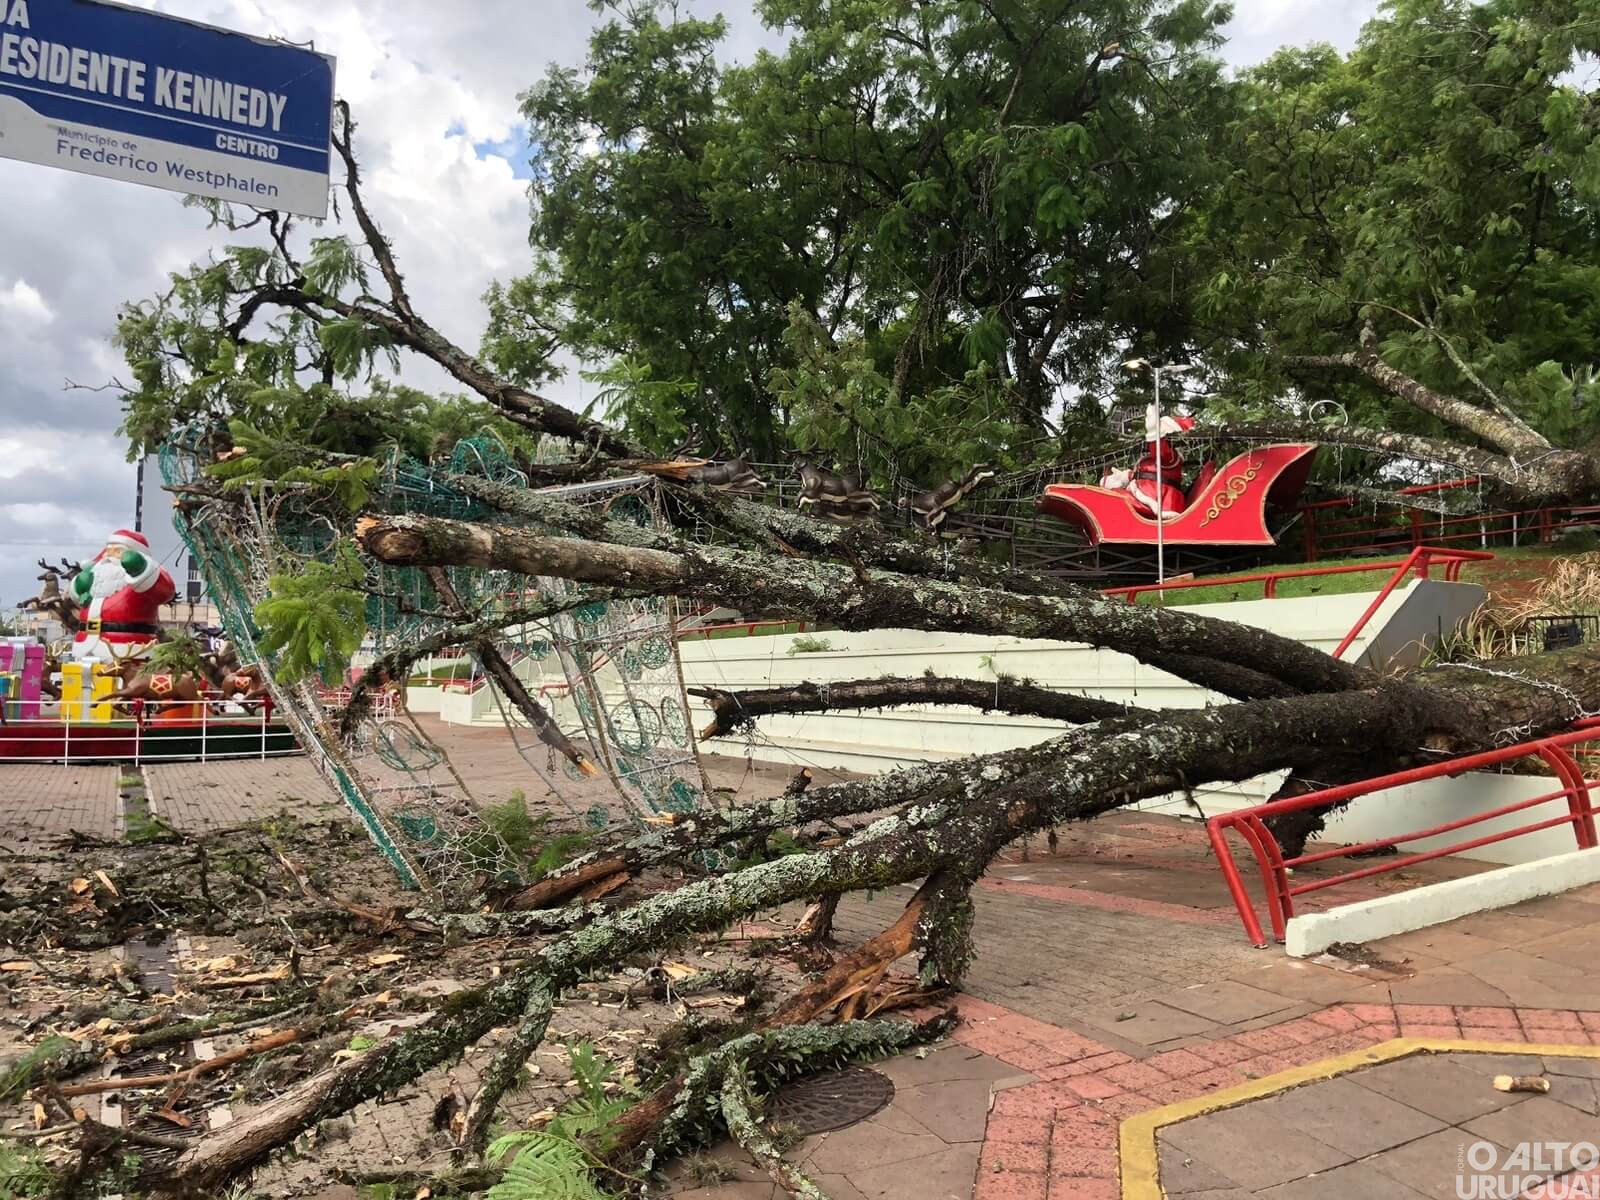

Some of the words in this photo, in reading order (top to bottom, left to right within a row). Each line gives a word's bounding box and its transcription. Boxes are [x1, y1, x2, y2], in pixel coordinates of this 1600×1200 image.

[154, 66, 288, 132] KENNEDY
[122, 139, 138, 151] de
[215, 133, 279, 160] CENTRO
[56, 139, 158, 174] Frederico
[165, 161, 279, 197] Westphalen
